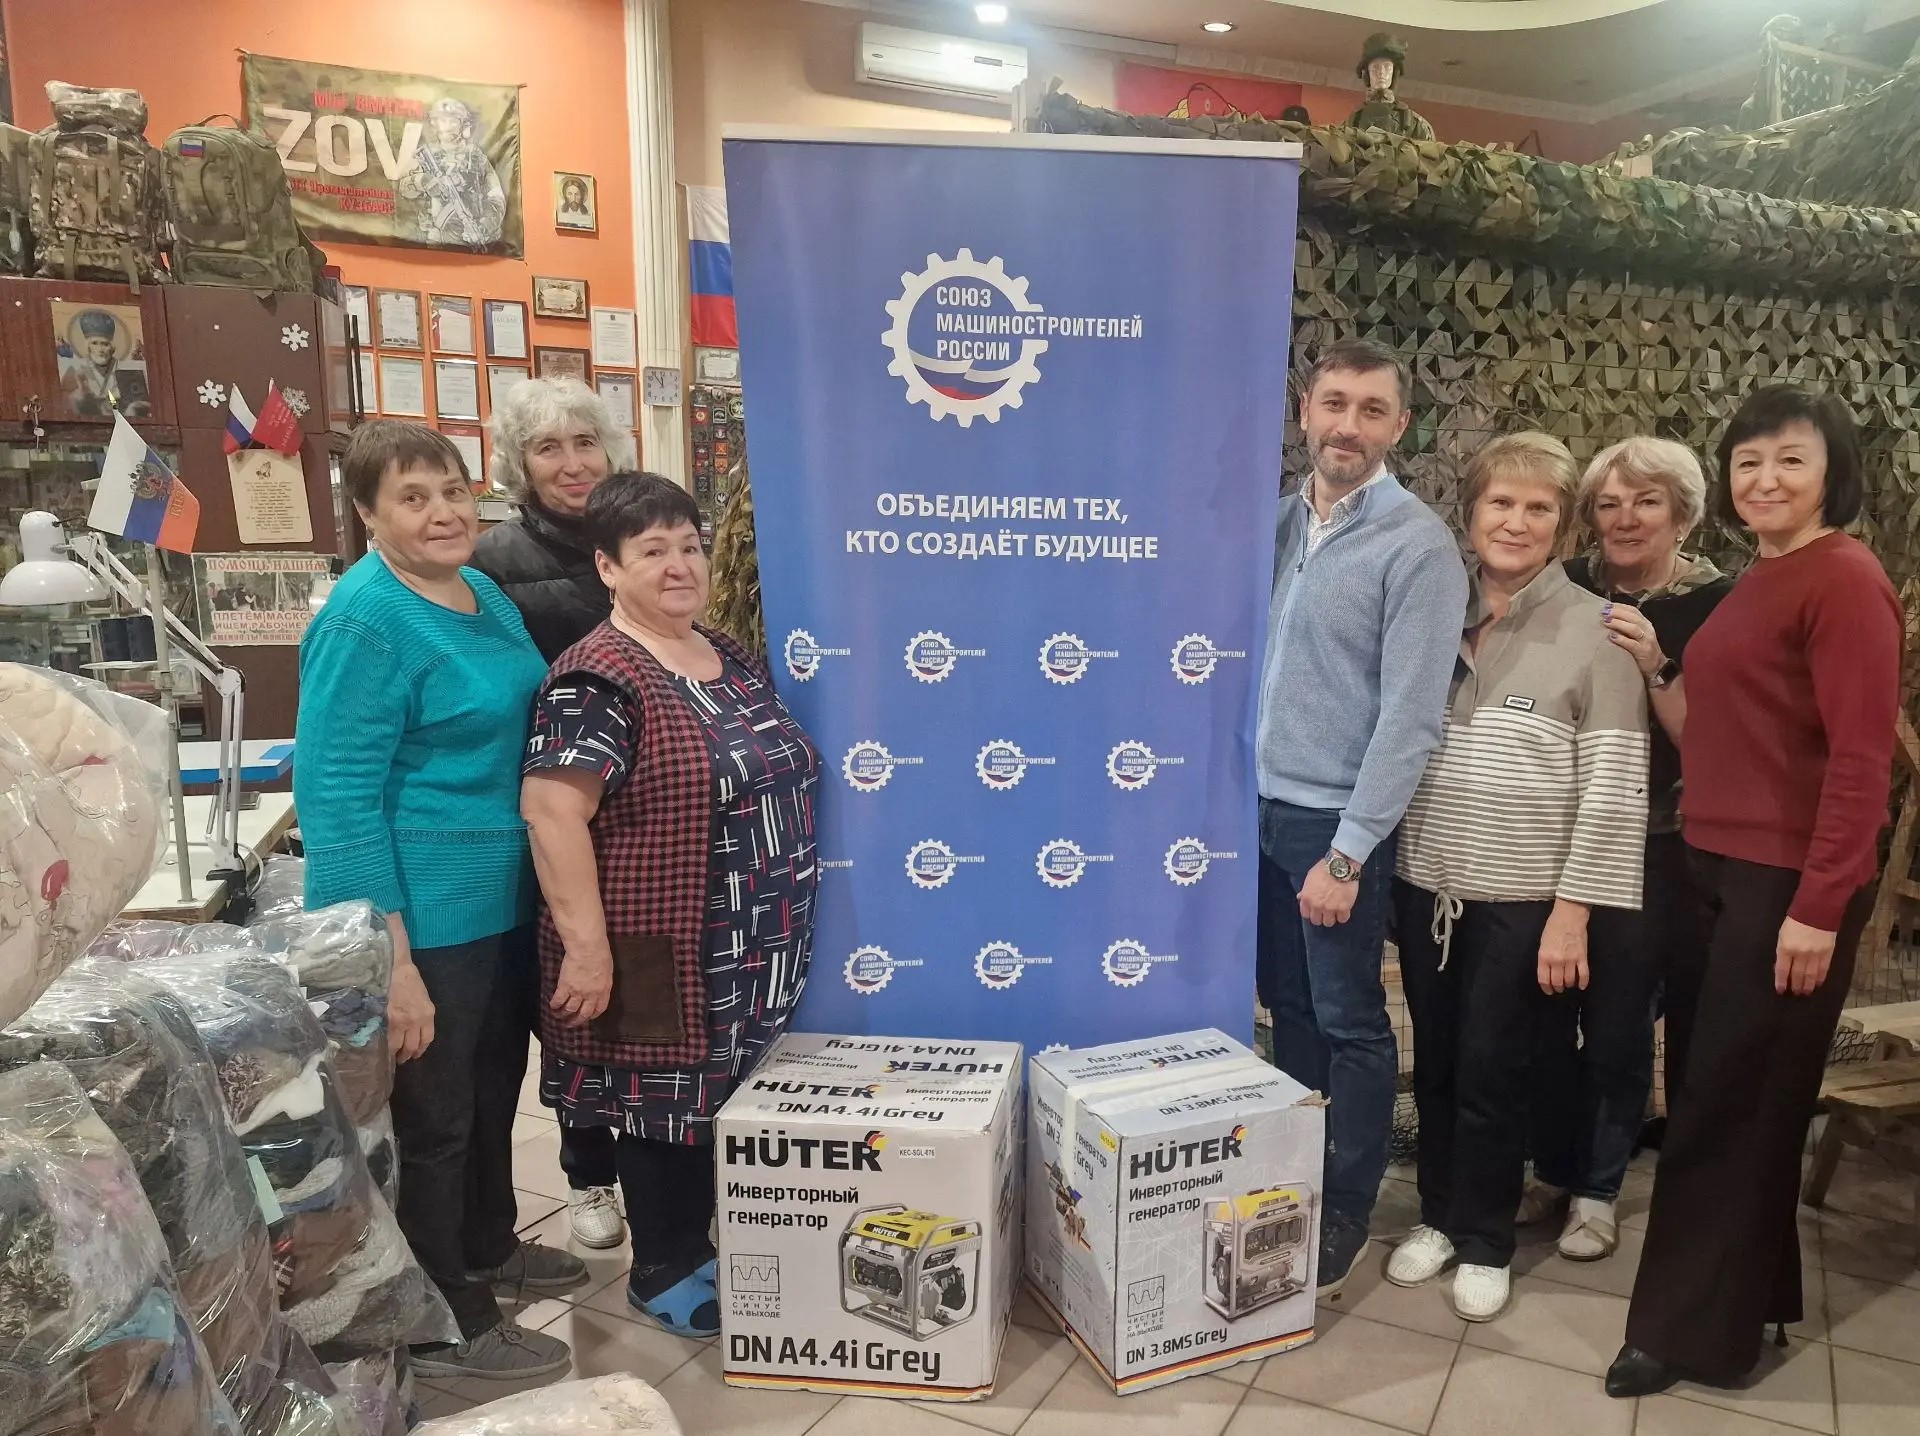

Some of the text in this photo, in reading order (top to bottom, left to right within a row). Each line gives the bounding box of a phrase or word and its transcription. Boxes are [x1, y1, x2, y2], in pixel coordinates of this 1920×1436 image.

[262, 105, 425, 181] ZOV
[936, 286, 992, 308] СОЮЗ
[936, 312, 1143, 339] МАШИНОСТРОИТЕЛЕЙ
[936, 339, 1011, 361] РОССИИ
[876, 493, 1129, 524] ОБЪЕДИНЯЕМ ТЕХ,
[846, 529, 1159, 563] КТО СОЗДАЁТ БУДУЩЕЕ
[208, 558, 327, 572] ПОМОЩЬ НАШИМ
[215, 622, 248, 630] ИЩЕМ
[251, 621, 301, 630] РАБОЧИЕ
[825, 1039, 881, 1052] Grey
[945, 1046, 976, 1056] DN
[882, 1060, 1003, 1075] HÜTER
[1087, 1053, 1121, 1064] Grey
[1148, 1046, 1232, 1068] HÜTER
[752, 1080, 883, 1099] HÜTER
[777, 1102, 811, 1114] DN
[883, 1108, 945, 1122] Grey
[1160, 1105, 1180, 1117] DN
[1228, 1092, 1264, 1105] Grey
[726, 1130, 890, 1172] HÜTER
[1076, 1132, 1107, 1168] генератор
[1130, 1125, 1247, 1180] HÜTER
[1076, 1150, 1094, 1180] Grey
[727, 1182, 859, 1204] Инверторный
[1129, 1169, 1223, 1202] Инверторный
[728, 1209, 828, 1230] генератор
[1128, 1196, 1200, 1223] генератор
[732, 1302, 781, 1310] СИНУС
[746, 1310, 781, 1319] ВЫХОДЕ
[1126, 1326, 1228, 1366] DN 3.8MS Grey
[730, 1335, 941, 1382] DN A4.4i Grey
